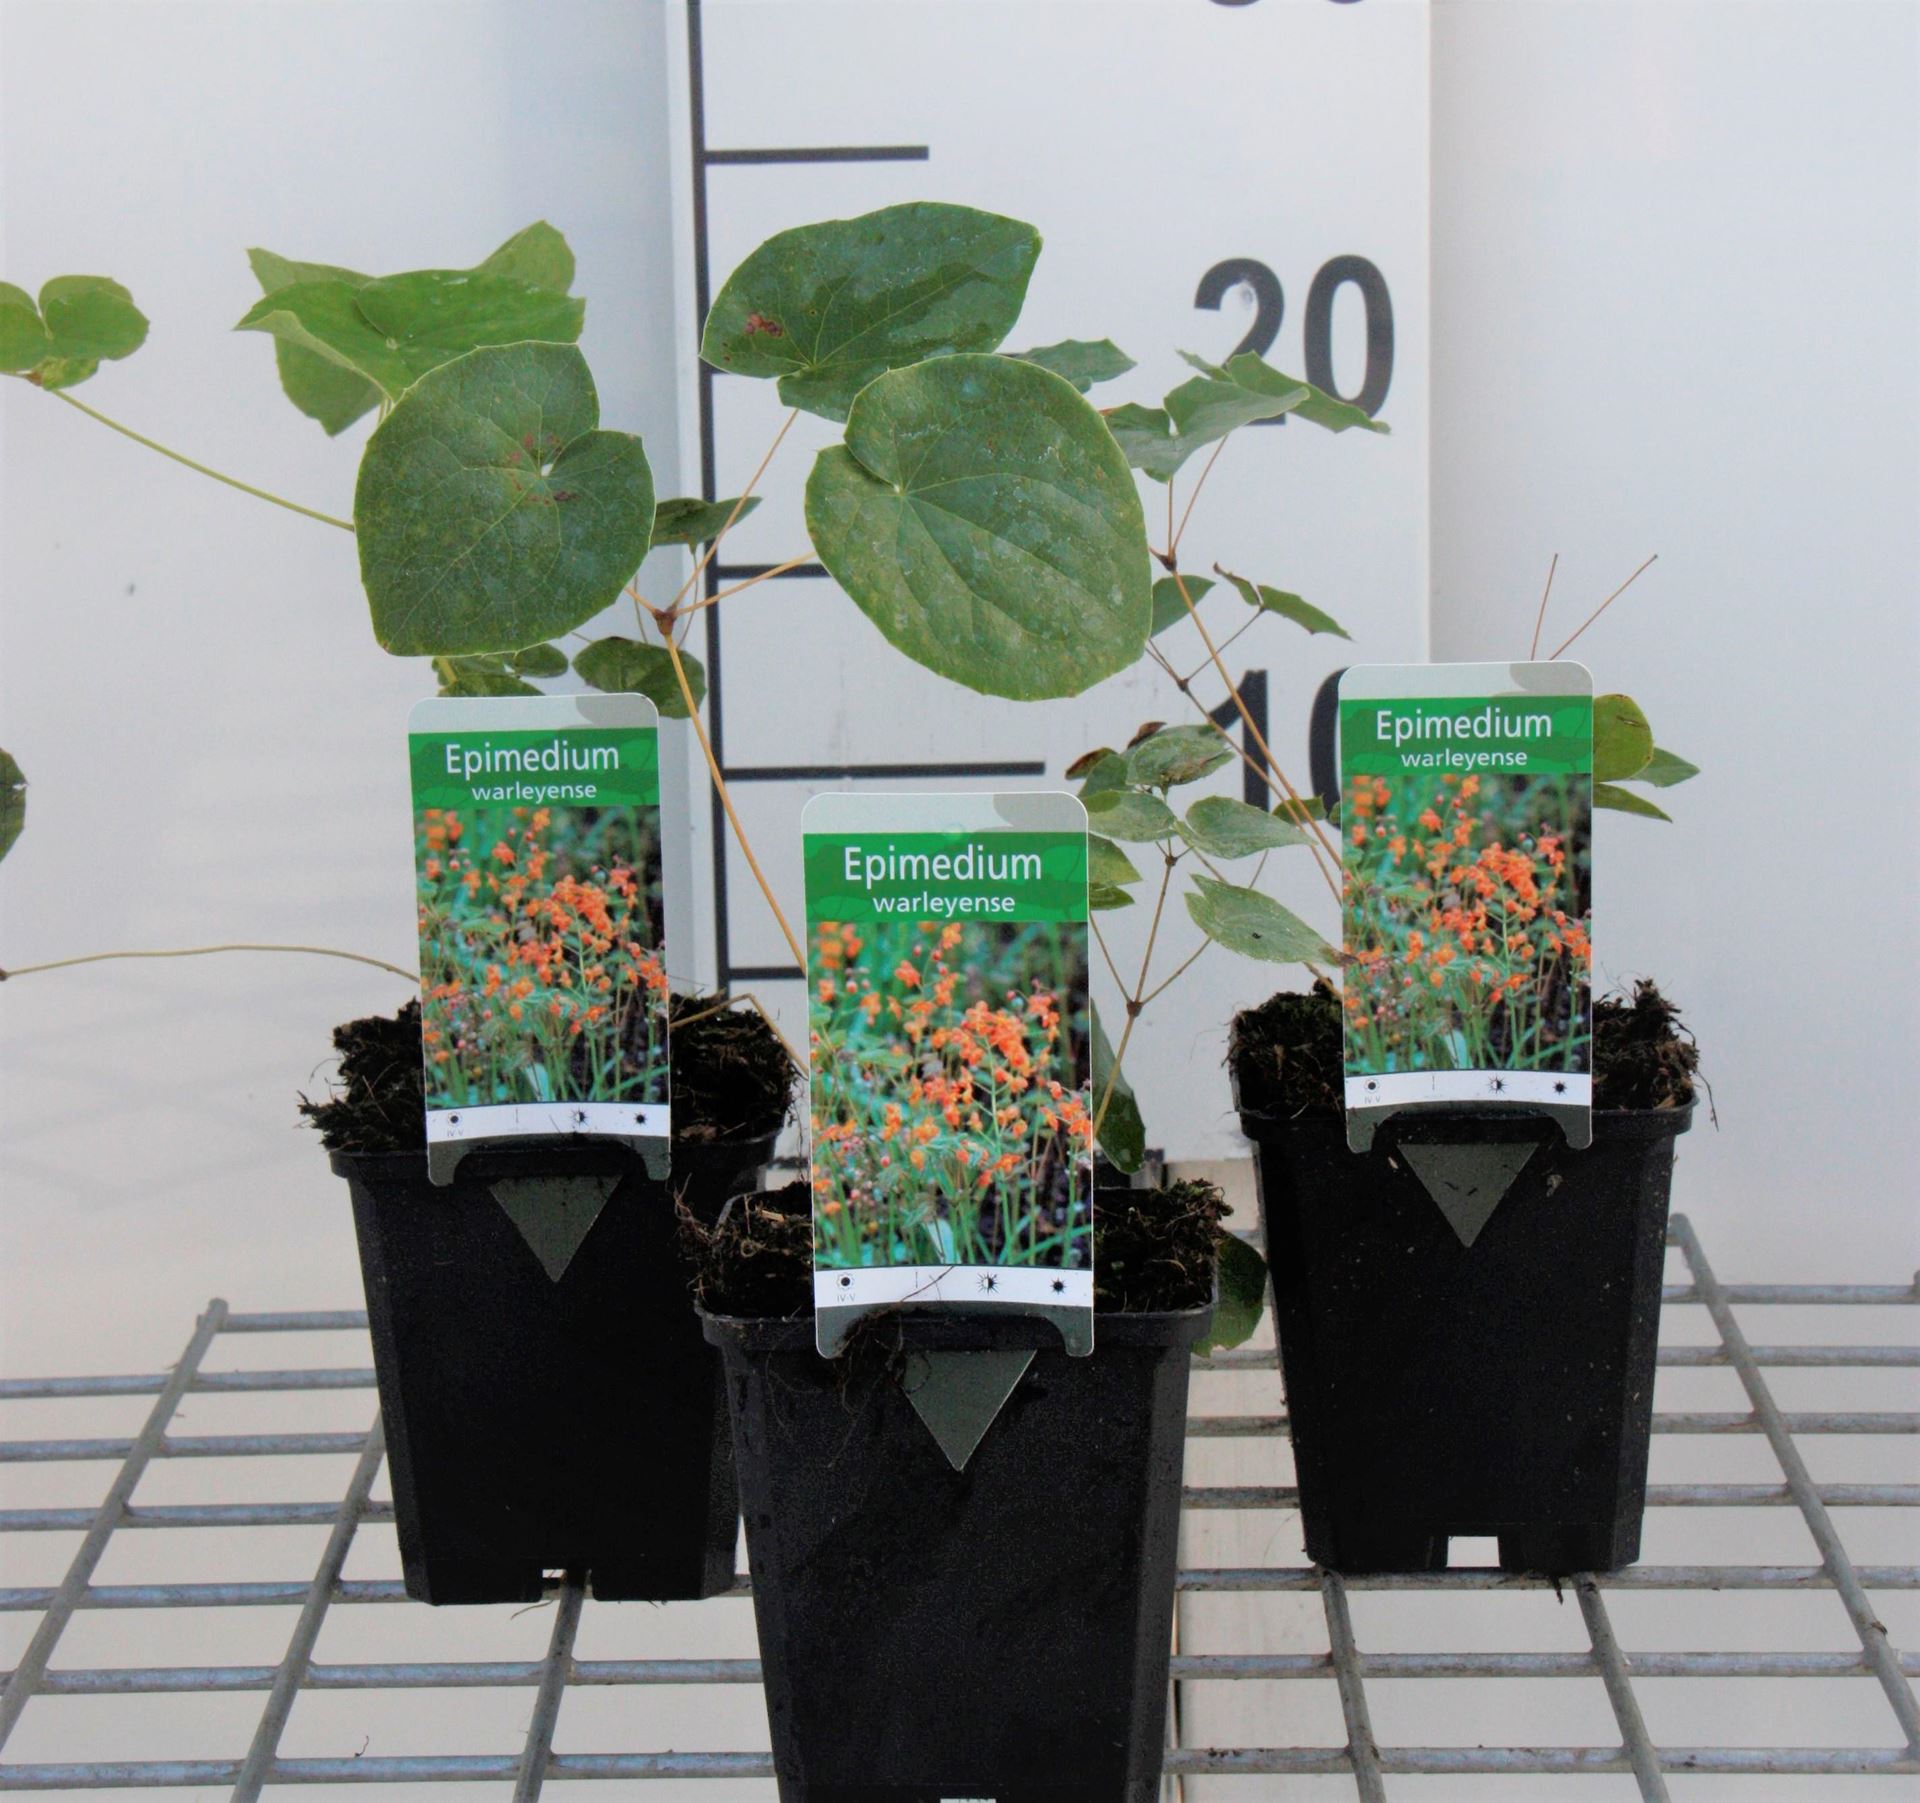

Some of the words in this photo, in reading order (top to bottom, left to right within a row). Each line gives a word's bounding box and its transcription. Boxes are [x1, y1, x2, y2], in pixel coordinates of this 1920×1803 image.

[1194, 254, 1394, 425] 20
[1376, 706, 1553, 748] Epimedium
[445, 739, 620, 781] Epimedium
[1400, 748, 1528, 772] warleyense
[471, 781, 598, 804] warleyense
[844, 844, 1042, 890] Epimedium
[872, 891, 1016, 918] warleyense
